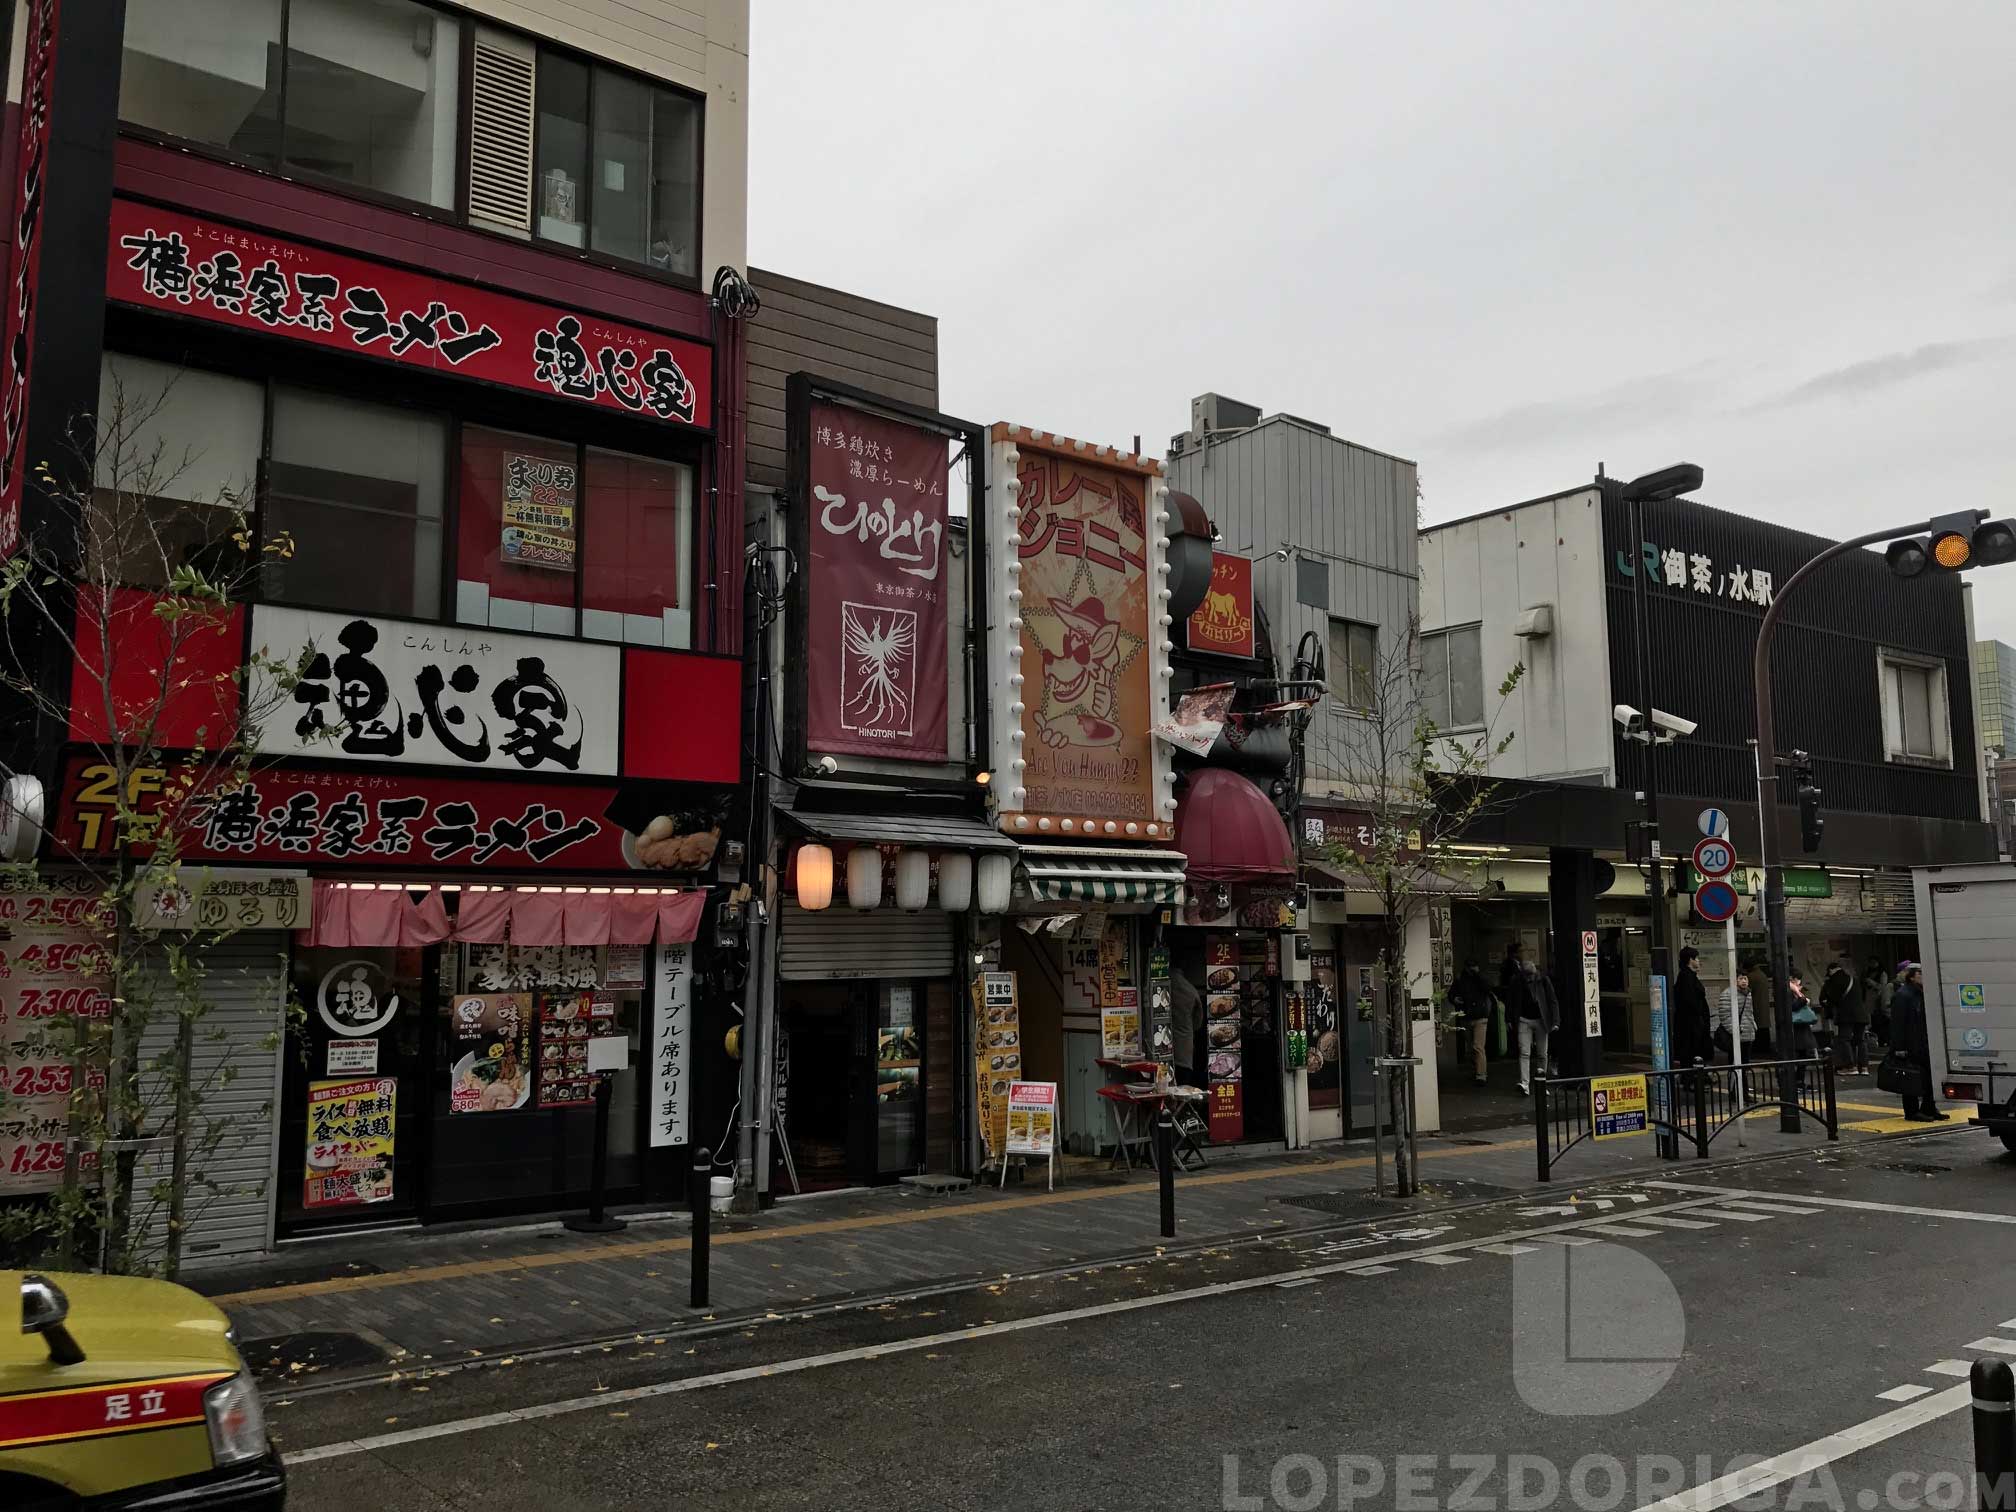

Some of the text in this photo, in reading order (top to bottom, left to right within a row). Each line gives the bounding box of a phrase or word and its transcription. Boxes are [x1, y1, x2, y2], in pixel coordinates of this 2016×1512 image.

[193, 226, 310, 262] よこはまいえけい
[593, 328, 647, 347] こんしんや
[535, 316, 695, 423] 魂心家
[816, 426, 894, 461] 博多鶏炊き
[849, 458, 943, 497] 濃厚らーめん
[534, 485, 558, 506] 22
[814, 485, 942, 580] ひのとり
[1018, 513, 1145, 573] ジョニー
[1661, 547, 1775, 607] 御茶ノ水駅
[403, 634, 494, 657] こんしんや
[295, 619, 583, 770] 魂心家
[858, 727, 896, 740] HINOTORI
[75, 765, 166, 804] 2F
[270, 772, 397, 789] よこはまいえけい
[1703, 849, 1727, 867] 20
[200, 897, 298, 928] ゆるり
[1217, 943, 1230, 956] 2F
[16, 988, 112, 1019] 7,300円
[337, 967, 378, 1020] 魂
[987, 983, 1012, 995] 営業中
[1587, 970, 1599, 1034] 丸ノ内線
[12, 1065, 106, 1096] 2,53円
[1217, 1084, 1235, 1097] 全品
[9, 1142, 100, 1175] 1,25円
[314, 1140, 378, 1160] ライスバー
[104, 1388, 166, 1421] 足立
